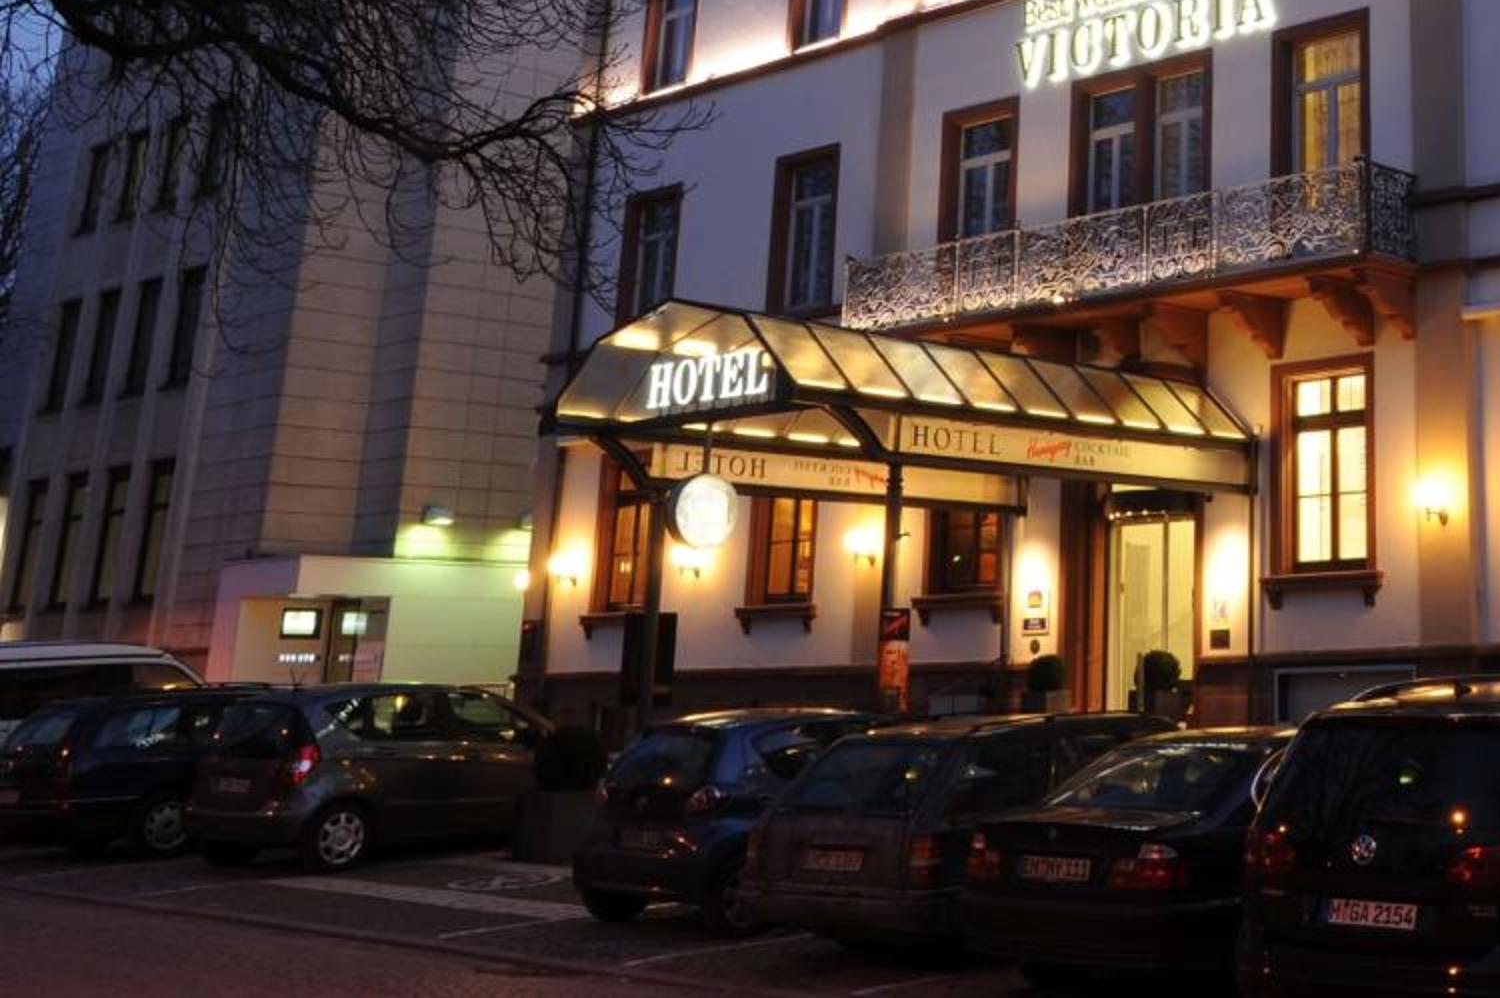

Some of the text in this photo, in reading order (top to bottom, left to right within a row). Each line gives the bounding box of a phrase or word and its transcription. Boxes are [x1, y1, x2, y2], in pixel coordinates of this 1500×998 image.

[646, 351, 769, 409] HOTEL
[911, 425, 1002, 455] HOTEL
[1373, 905, 1414, 926] 2154
